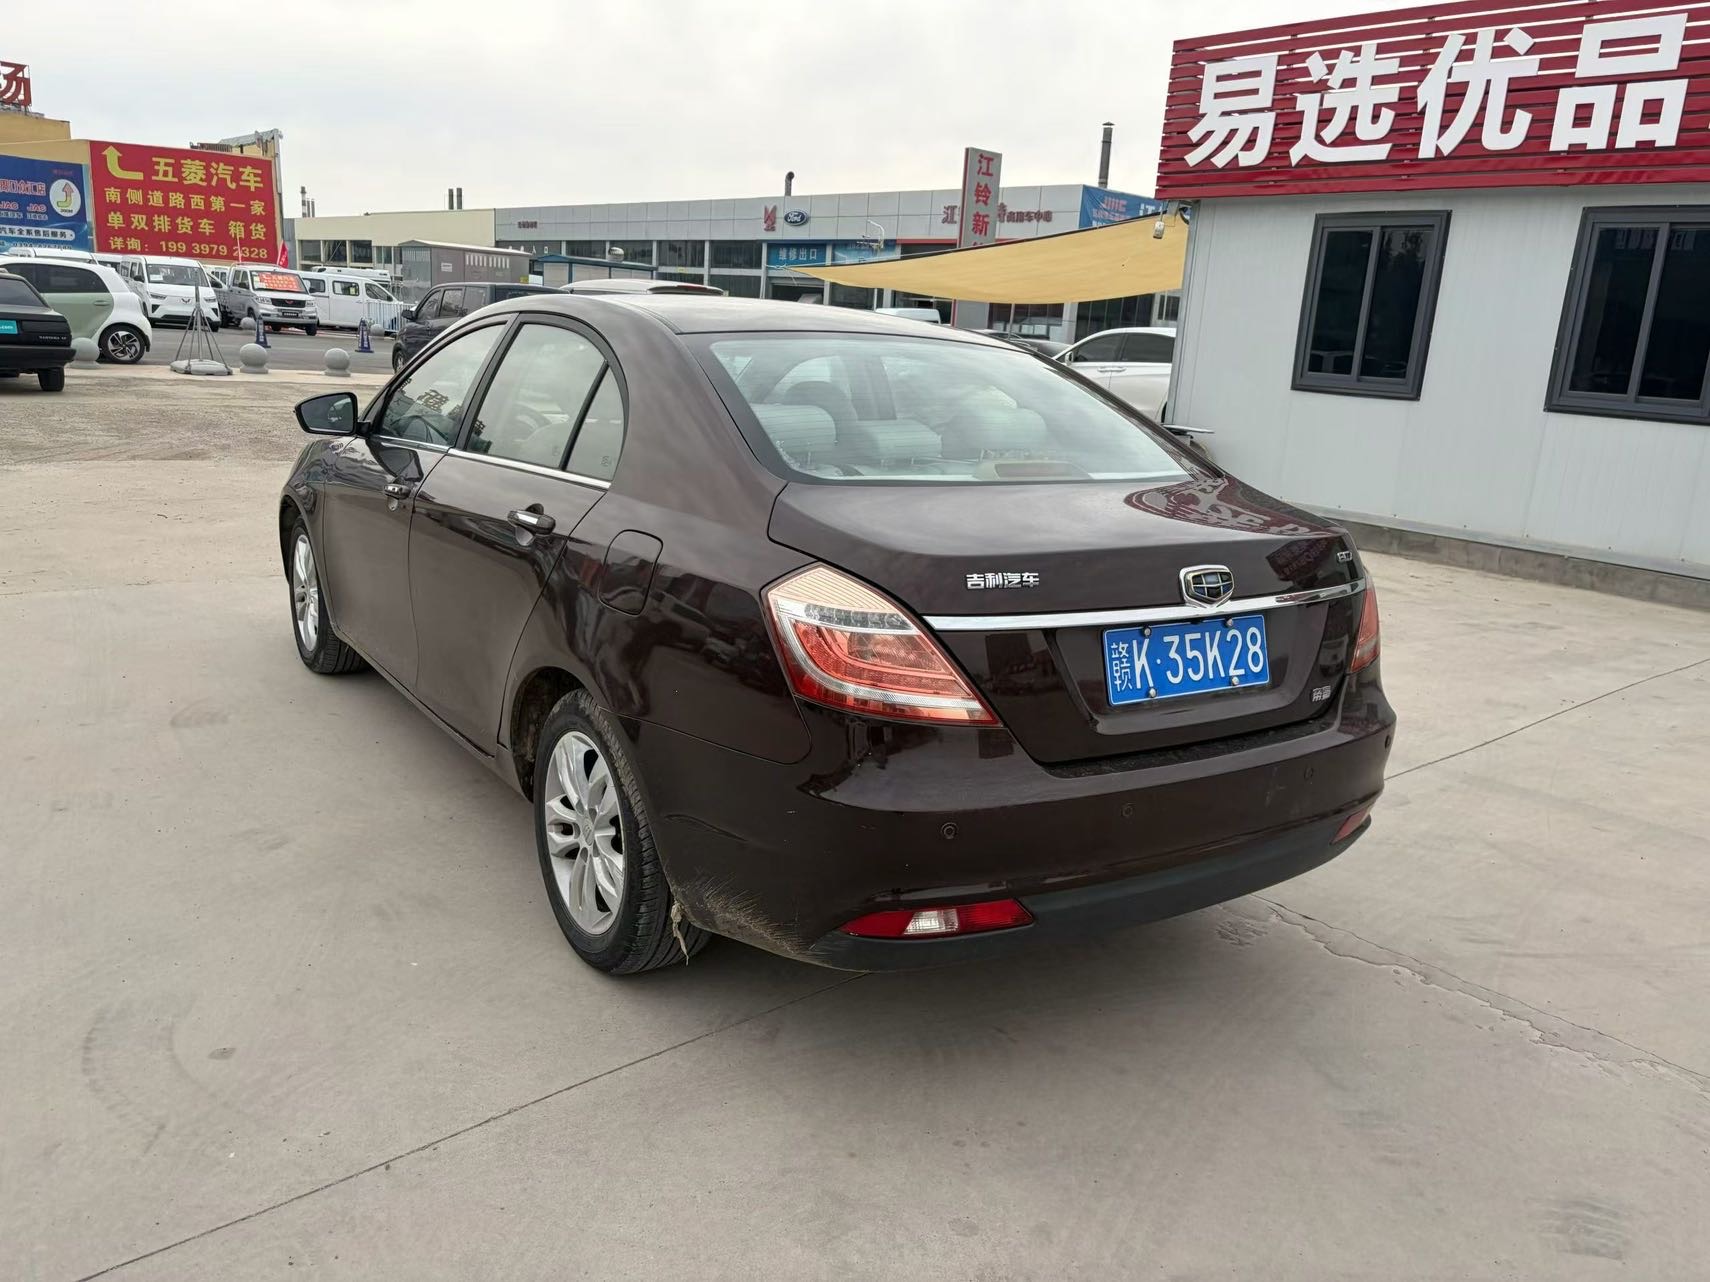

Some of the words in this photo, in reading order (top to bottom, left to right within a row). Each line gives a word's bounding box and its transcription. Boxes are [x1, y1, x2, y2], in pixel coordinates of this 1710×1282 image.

[1183, 13, 1688, 168] 易选优品
[152, 156, 263, 191] 五菱汽车
[104, 187, 266, 216] 南侧道路西第一家
[107, 211, 215, 236] 单双排货车
[228, 220, 267, 241] 箱货
[787, 210, 804, 223] Ford
[159, 241, 186, 253] 199
[192, 243, 228, 256] 3979
[233, 246, 268, 259] 2328
[965, 572, 1040, 590] 吉利汽车
